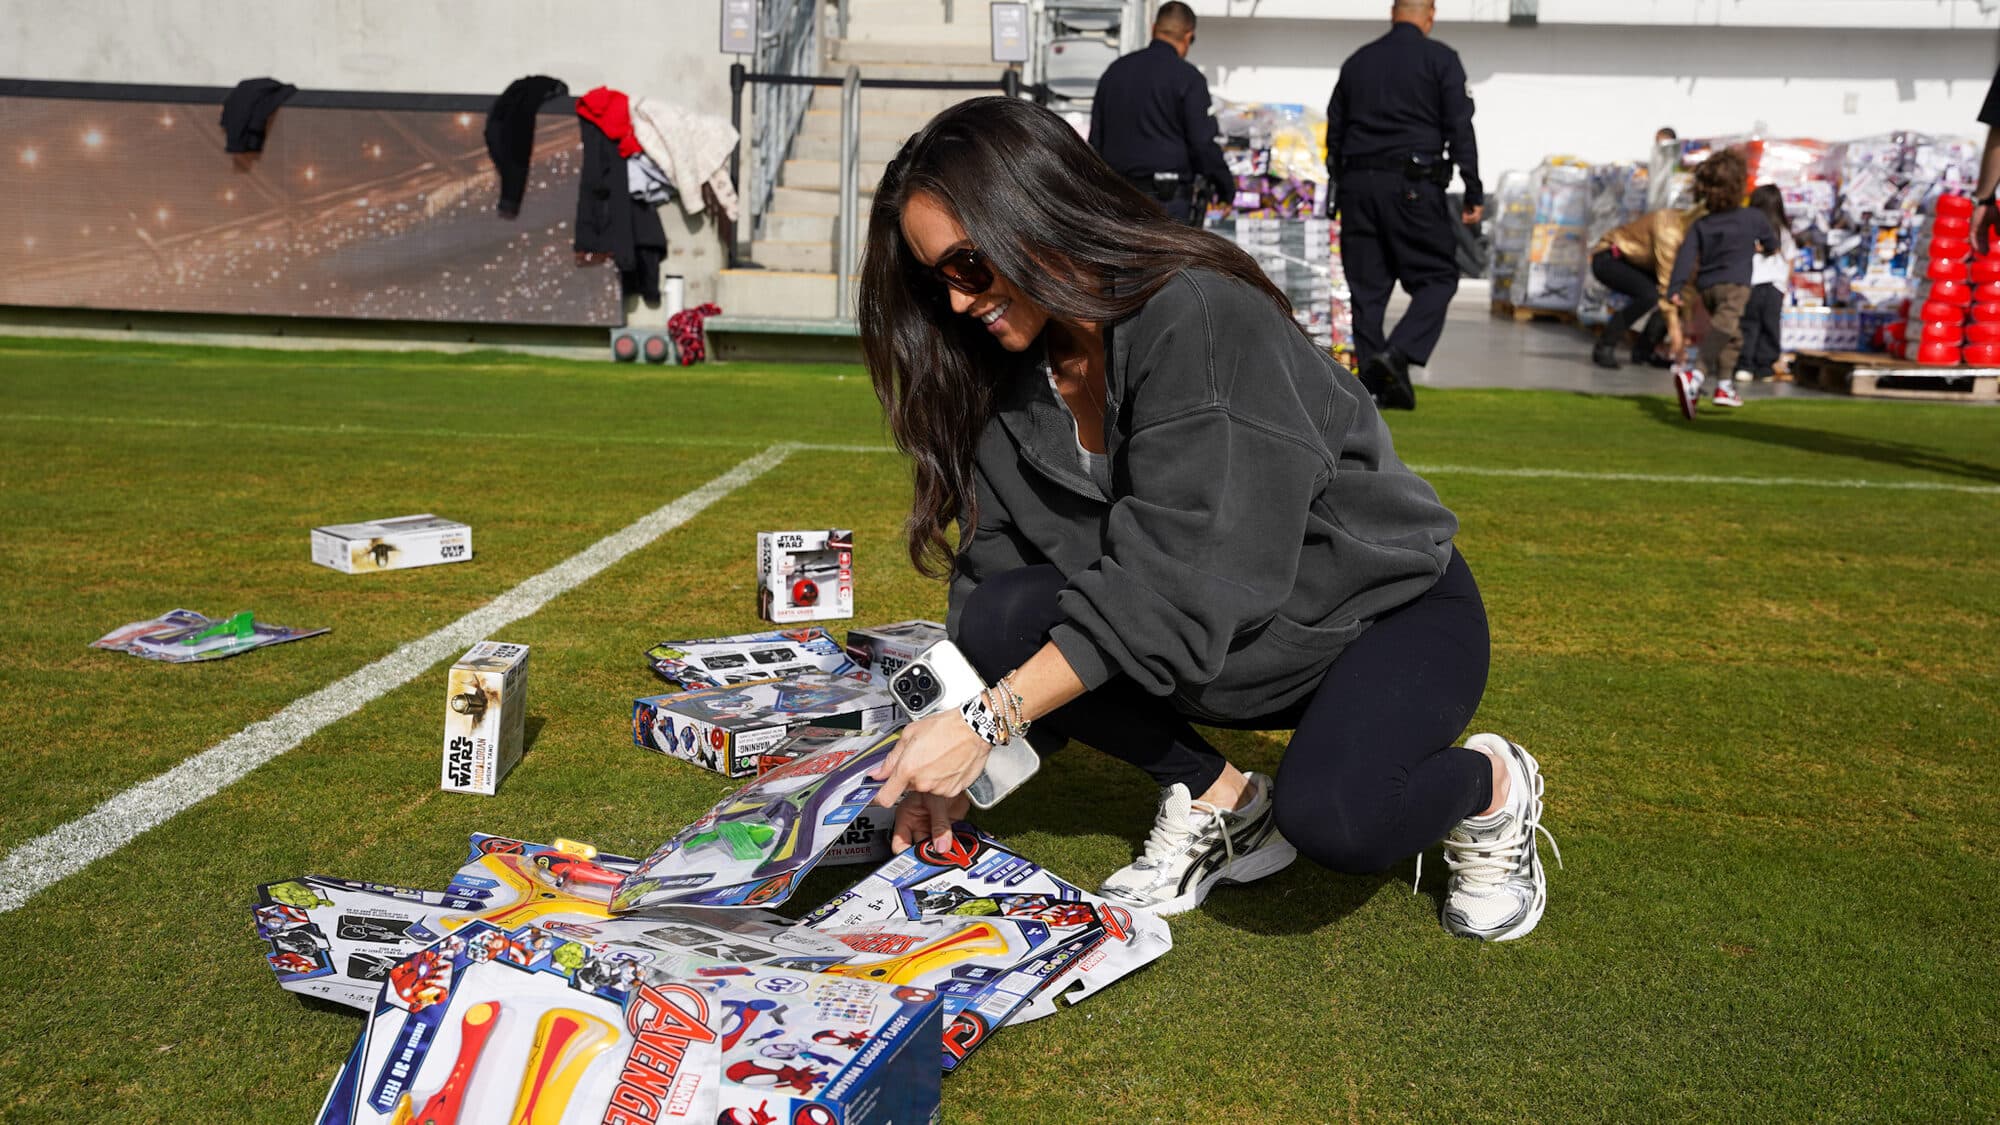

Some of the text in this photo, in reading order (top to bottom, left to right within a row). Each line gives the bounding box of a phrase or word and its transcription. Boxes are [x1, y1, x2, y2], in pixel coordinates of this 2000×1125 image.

[737, 741, 770, 754] WARNING:
[448, 736, 462, 786] STAR
[459, 737, 473, 787] WARS
[834, 830, 875, 846] ARS
[845, 846, 872, 855] VADER
[867, 899, 884, 911] 5+
[763, 977, 793, 993] 40
[881, 1015, 911, 1040] PLAYSET
[601, 982, 718, 1125] AVENGE
[378, 1079, 403, 1107] FEET!
[667, 1073, 701, 1115] MARVEL
